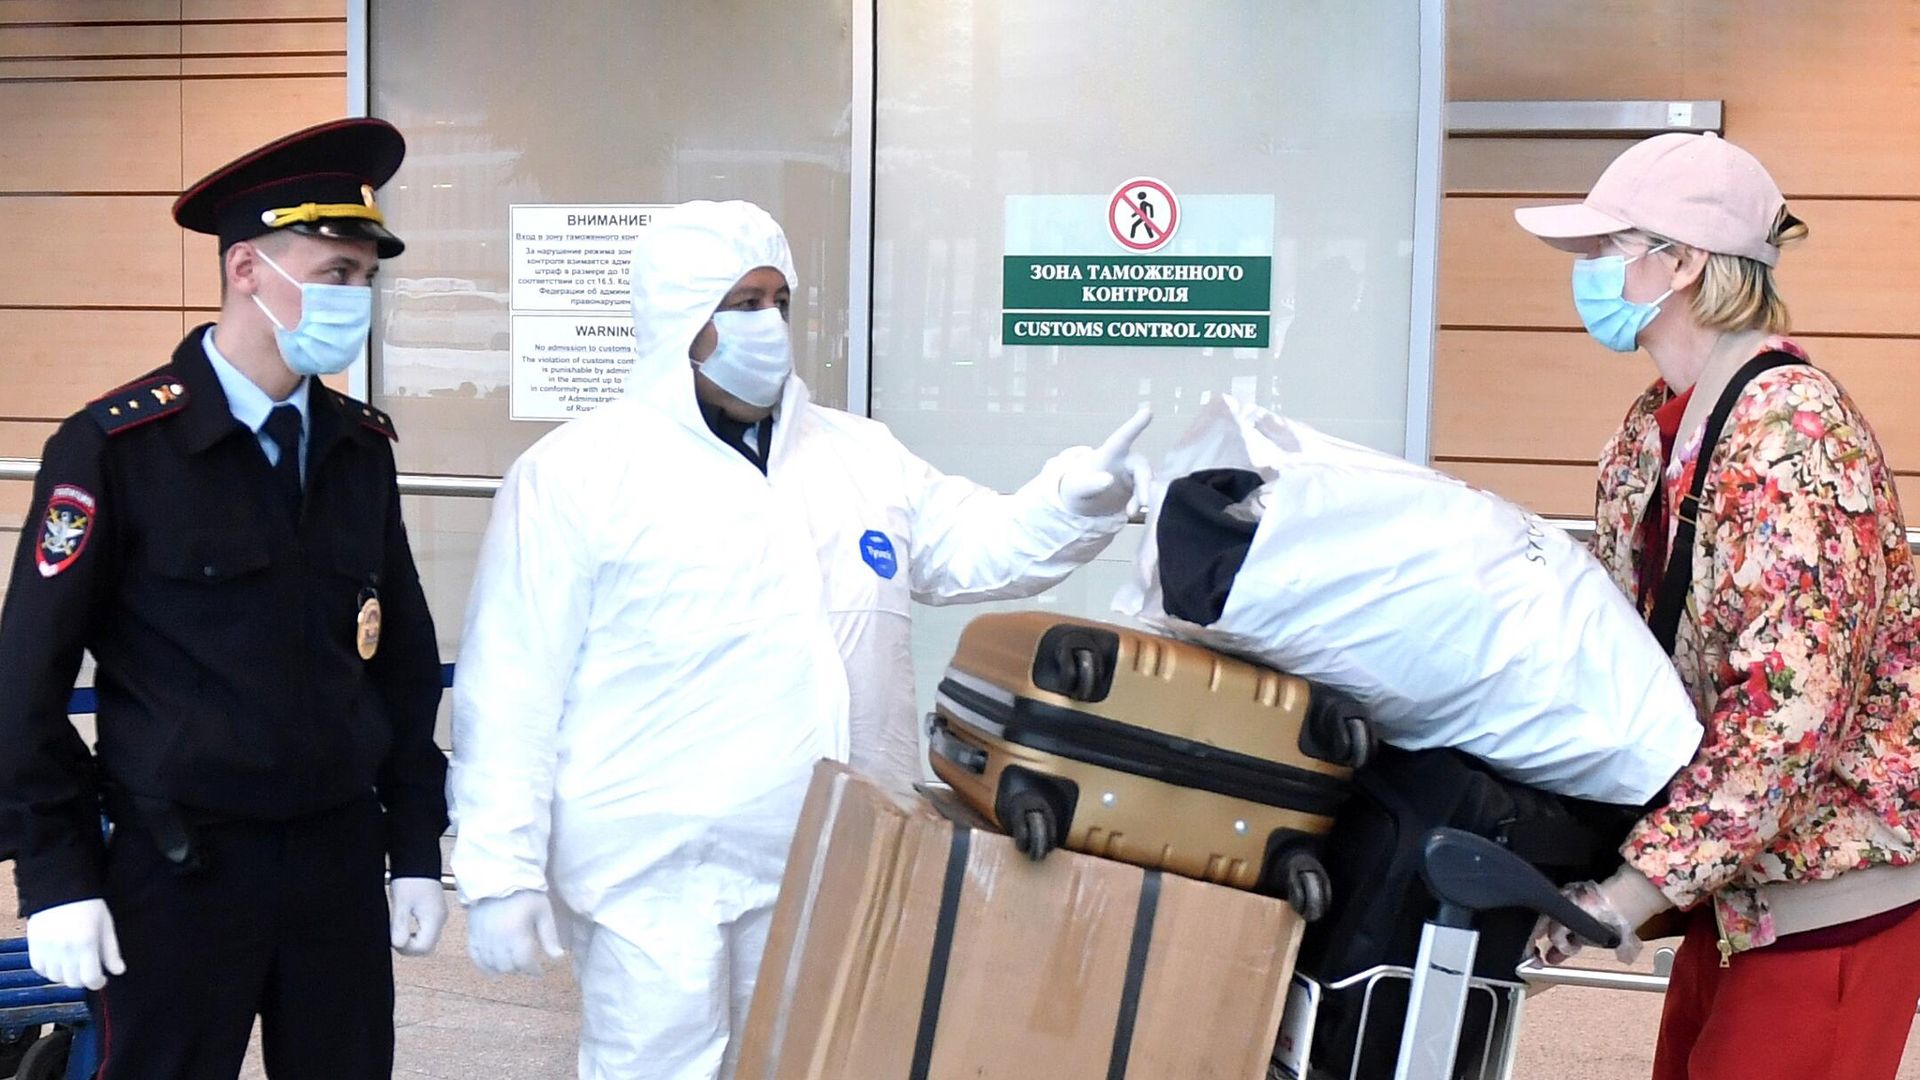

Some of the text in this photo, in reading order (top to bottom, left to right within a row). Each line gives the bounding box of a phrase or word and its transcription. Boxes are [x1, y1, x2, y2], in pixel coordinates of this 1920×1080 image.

[1029, 264, 1244, 281] ЗОНА ТАМОЖЕННОГО
[1081, 286, 1189, 303] КОНТРОЛЯ
[1013, 320, 1257, 339] CUSTOMS CONTROL ZONE
[594, 367, 604, 375] by
[540, 386, 580, 394] conformity
